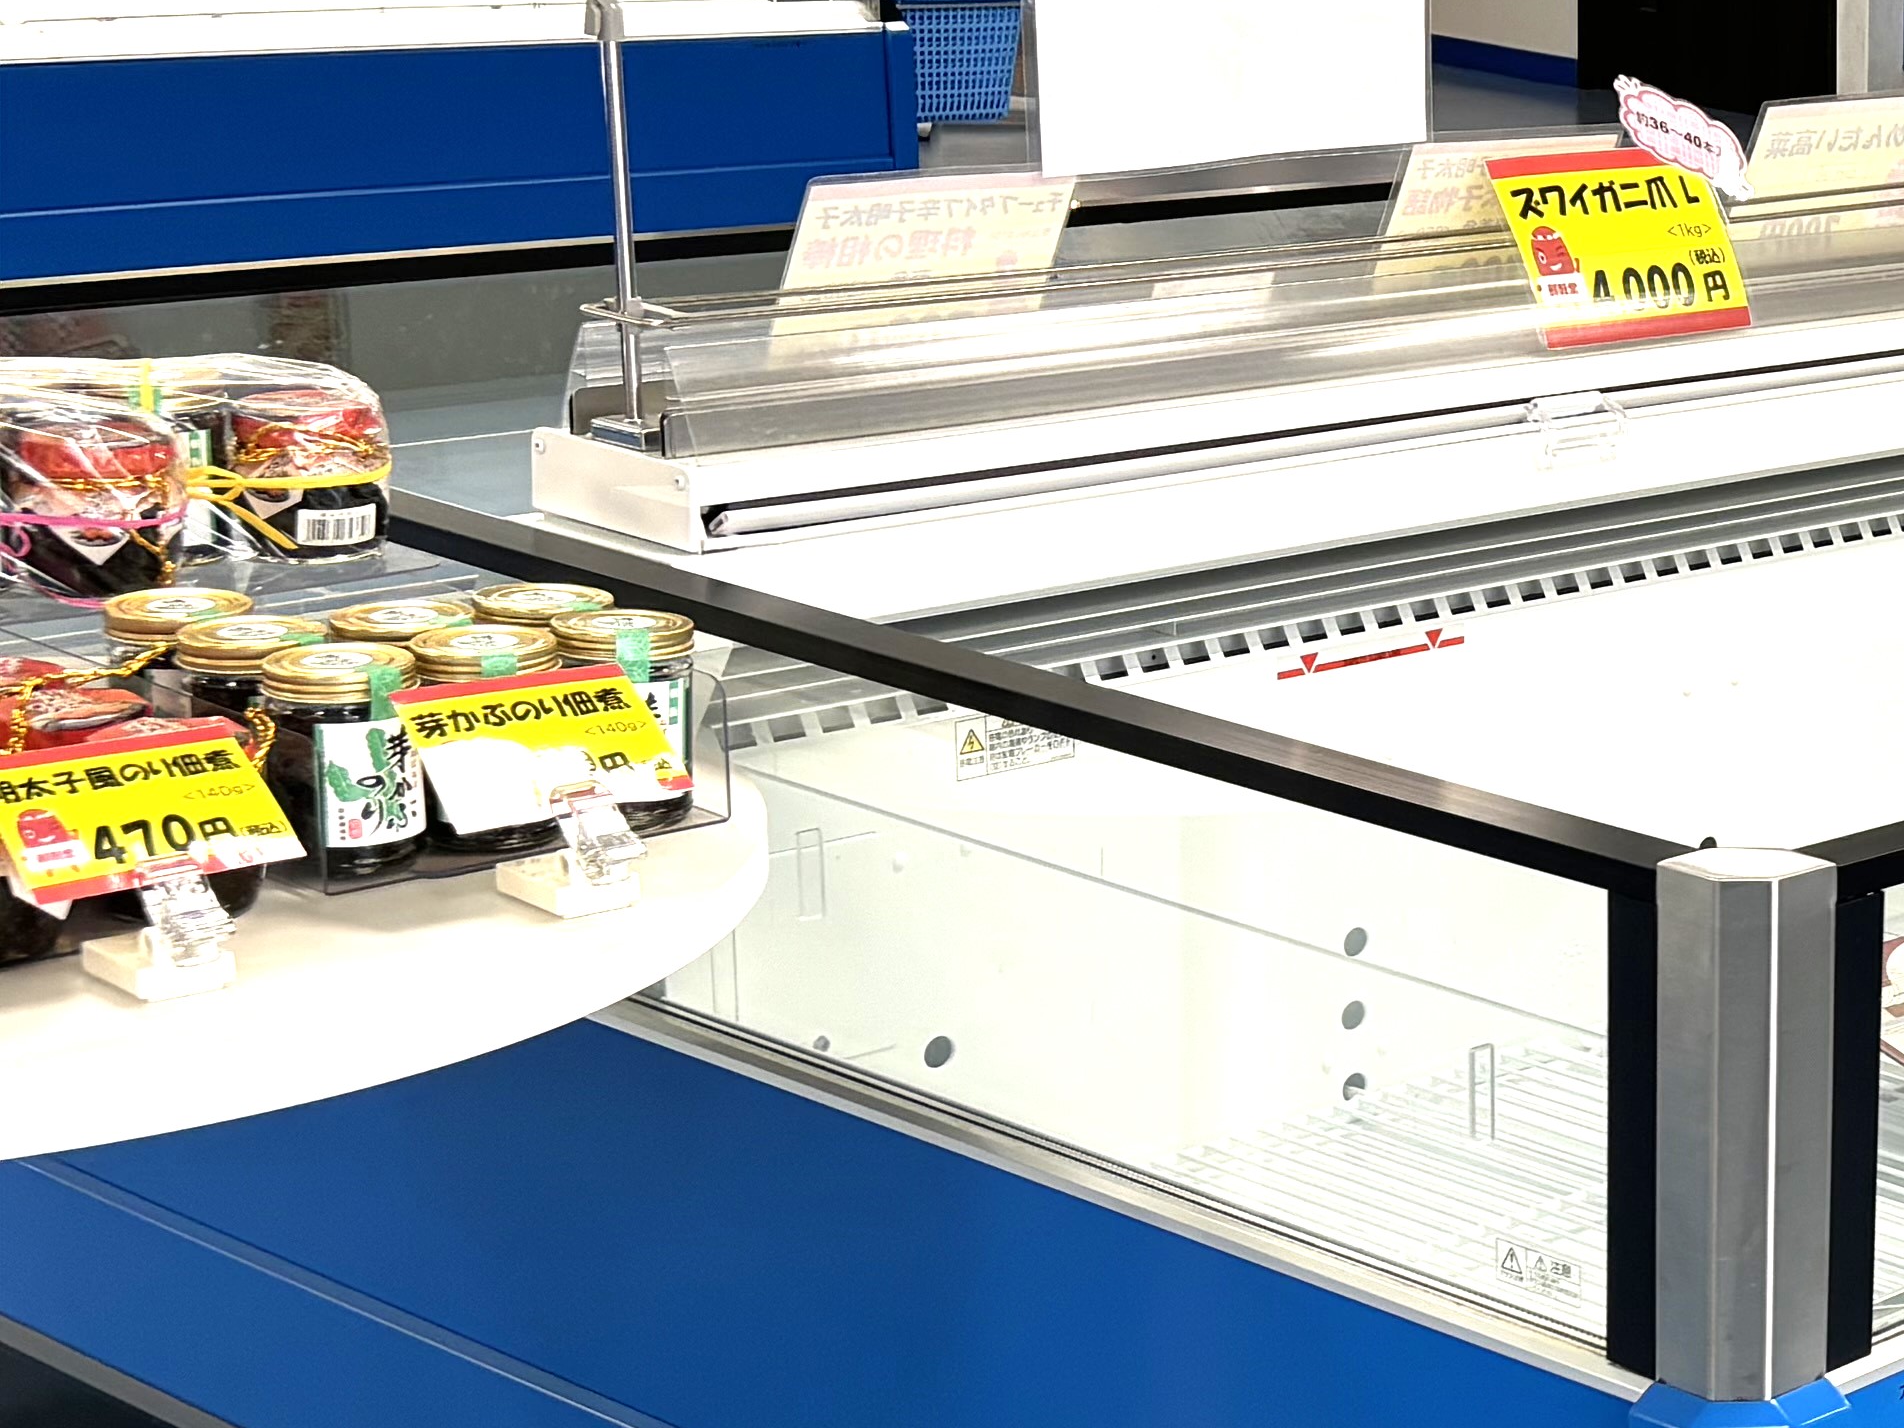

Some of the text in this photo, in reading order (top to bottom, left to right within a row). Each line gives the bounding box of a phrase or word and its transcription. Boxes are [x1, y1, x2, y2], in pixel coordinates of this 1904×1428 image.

[1678, 175, 1700, 205] L
[1667, 222, 1712, 238] <1kg>
[1592, 262, 1731, 311] 4000円
[411, 688, 633, 741] 芽かぶのり佃煮
[93, 812, 238, 865] 470円
